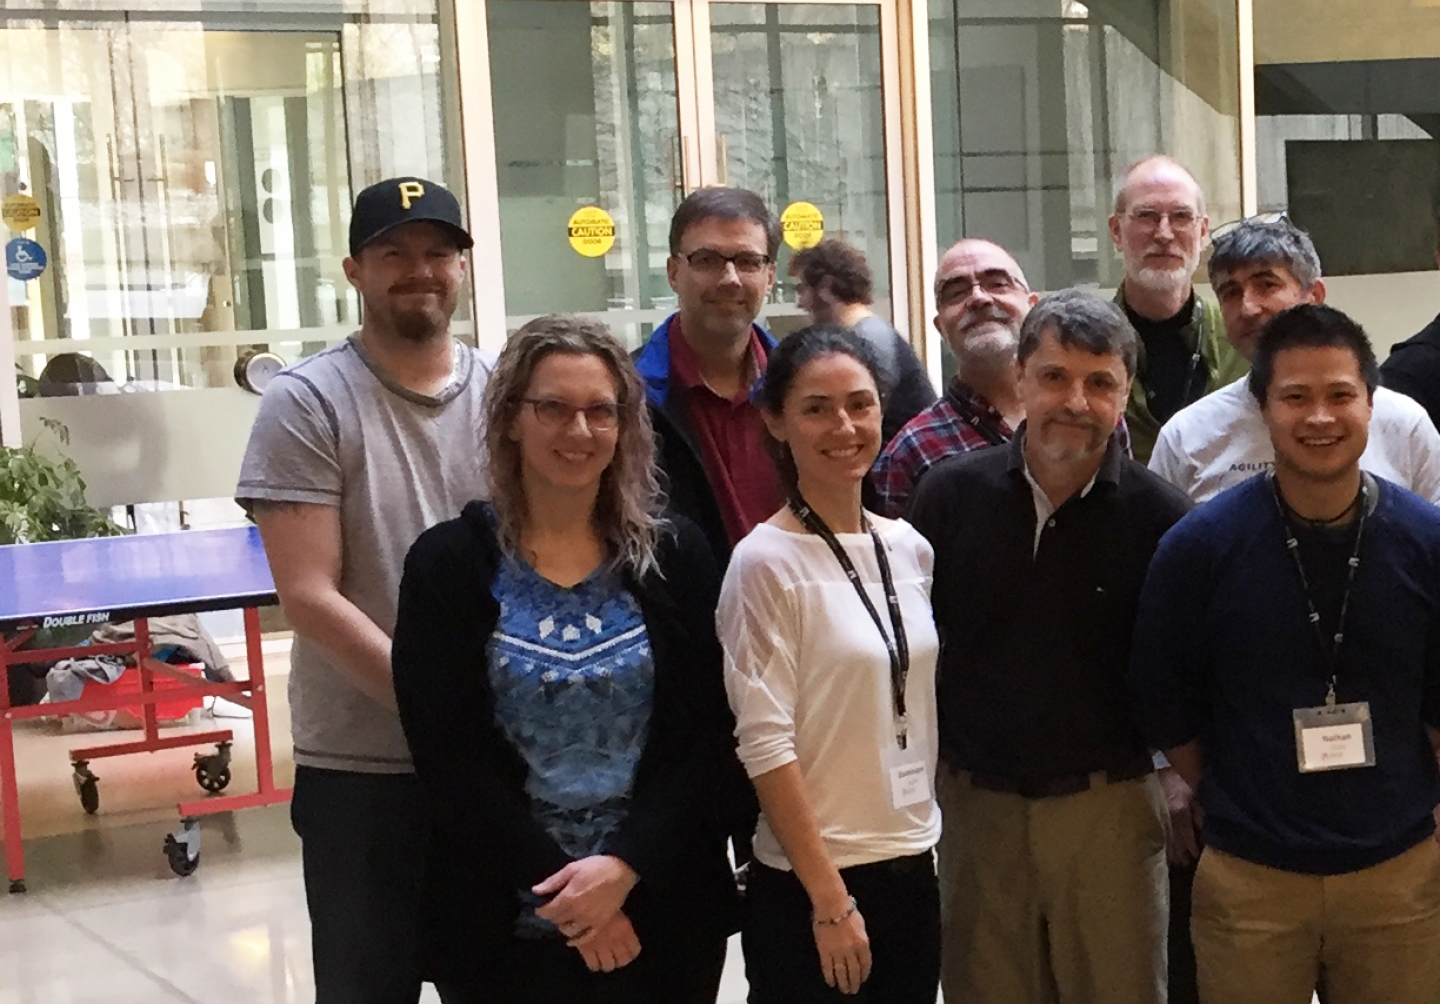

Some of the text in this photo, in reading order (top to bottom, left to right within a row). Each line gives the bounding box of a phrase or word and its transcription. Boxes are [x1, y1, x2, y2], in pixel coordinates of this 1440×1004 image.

[399, 181, 425, 210] P
[571, 226, 612, 237] CAUTION
[43, 614, 85, 629] DOUBLE
[86, 611, 110, 624] FISH
